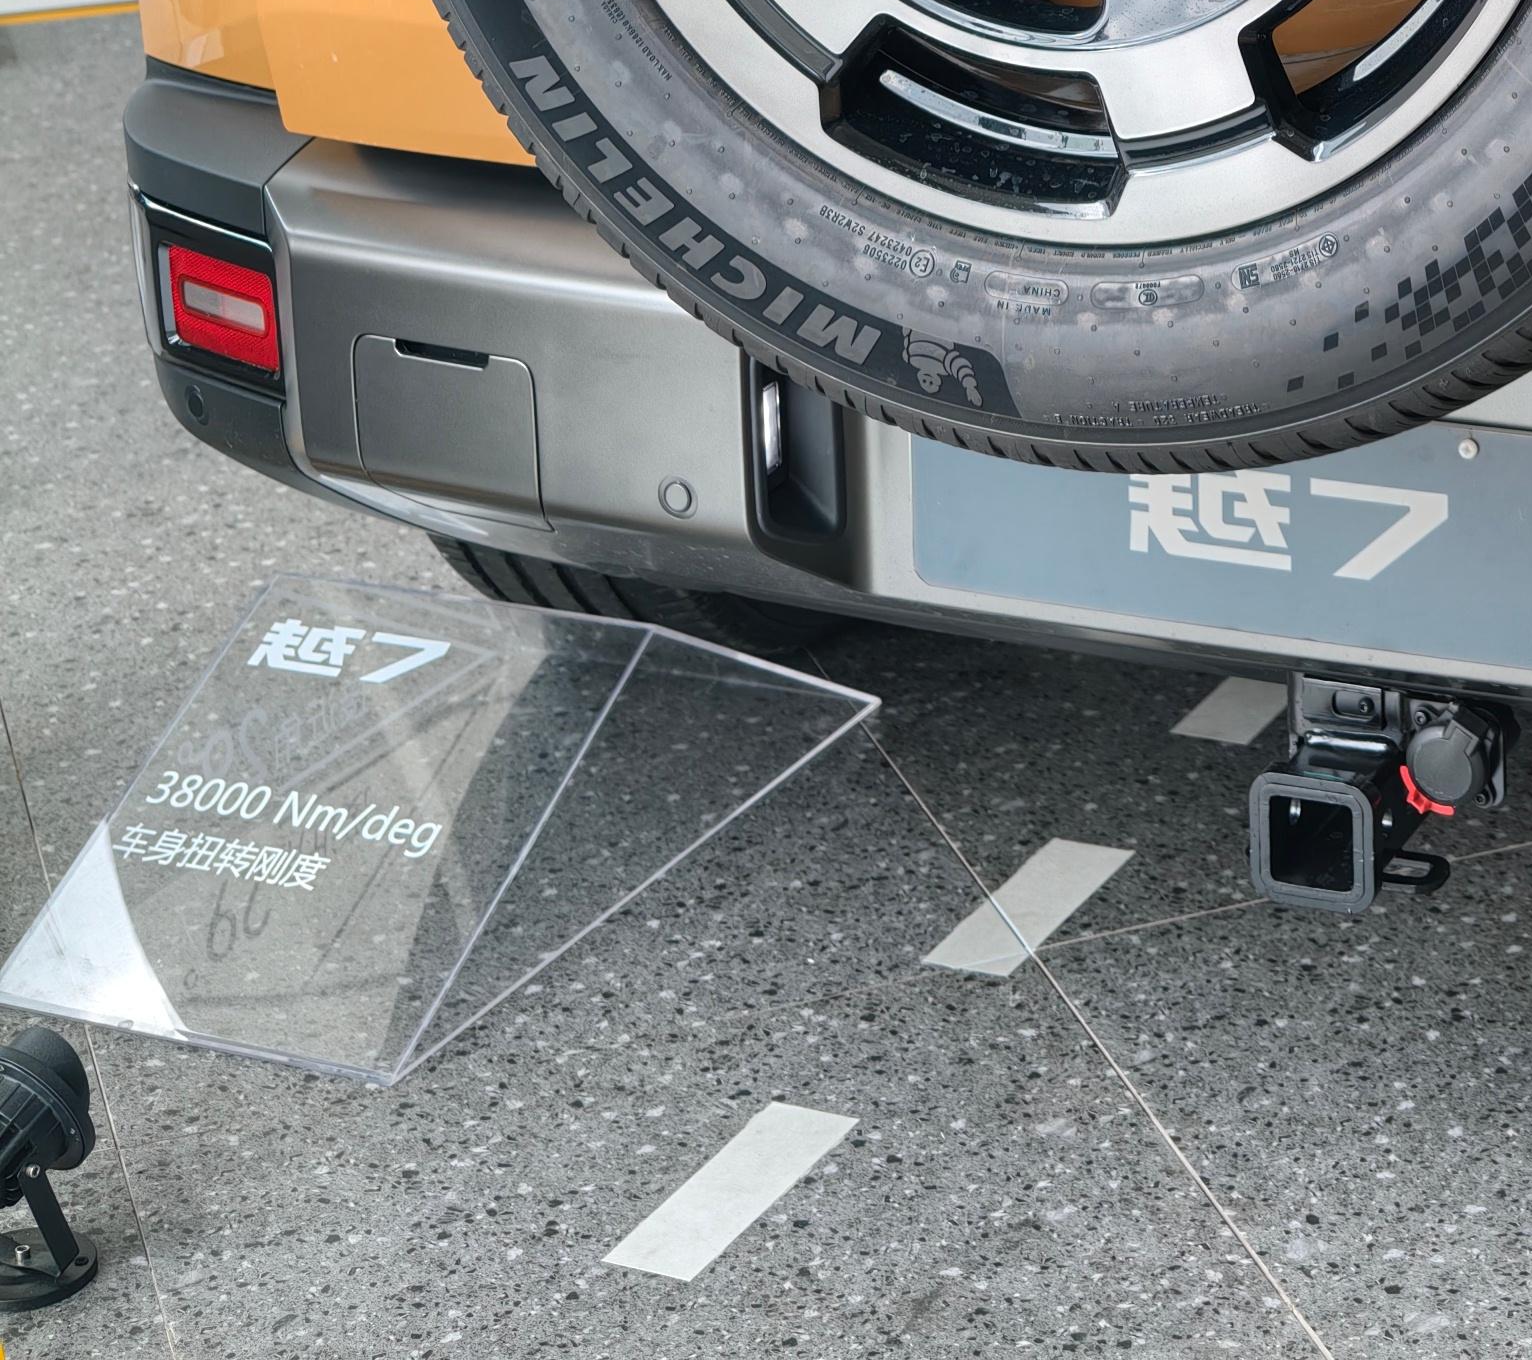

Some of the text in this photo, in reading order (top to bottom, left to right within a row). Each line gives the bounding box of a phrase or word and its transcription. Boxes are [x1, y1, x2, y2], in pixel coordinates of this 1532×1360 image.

[508, 52, 882, 364] MICHELIN
[914, 255, 929, 273] E2
[1022, 284, 1059, 297] CHINA
[996, 299, 1050, 316] MADE IN
[1128, 470, 1449, 581] 越7
[245, 617, 452, 684] 越7
[144, 769, 443, 859] 38000 Nm/deg
[112, 823, 331, 892] 车身扭转刚度
